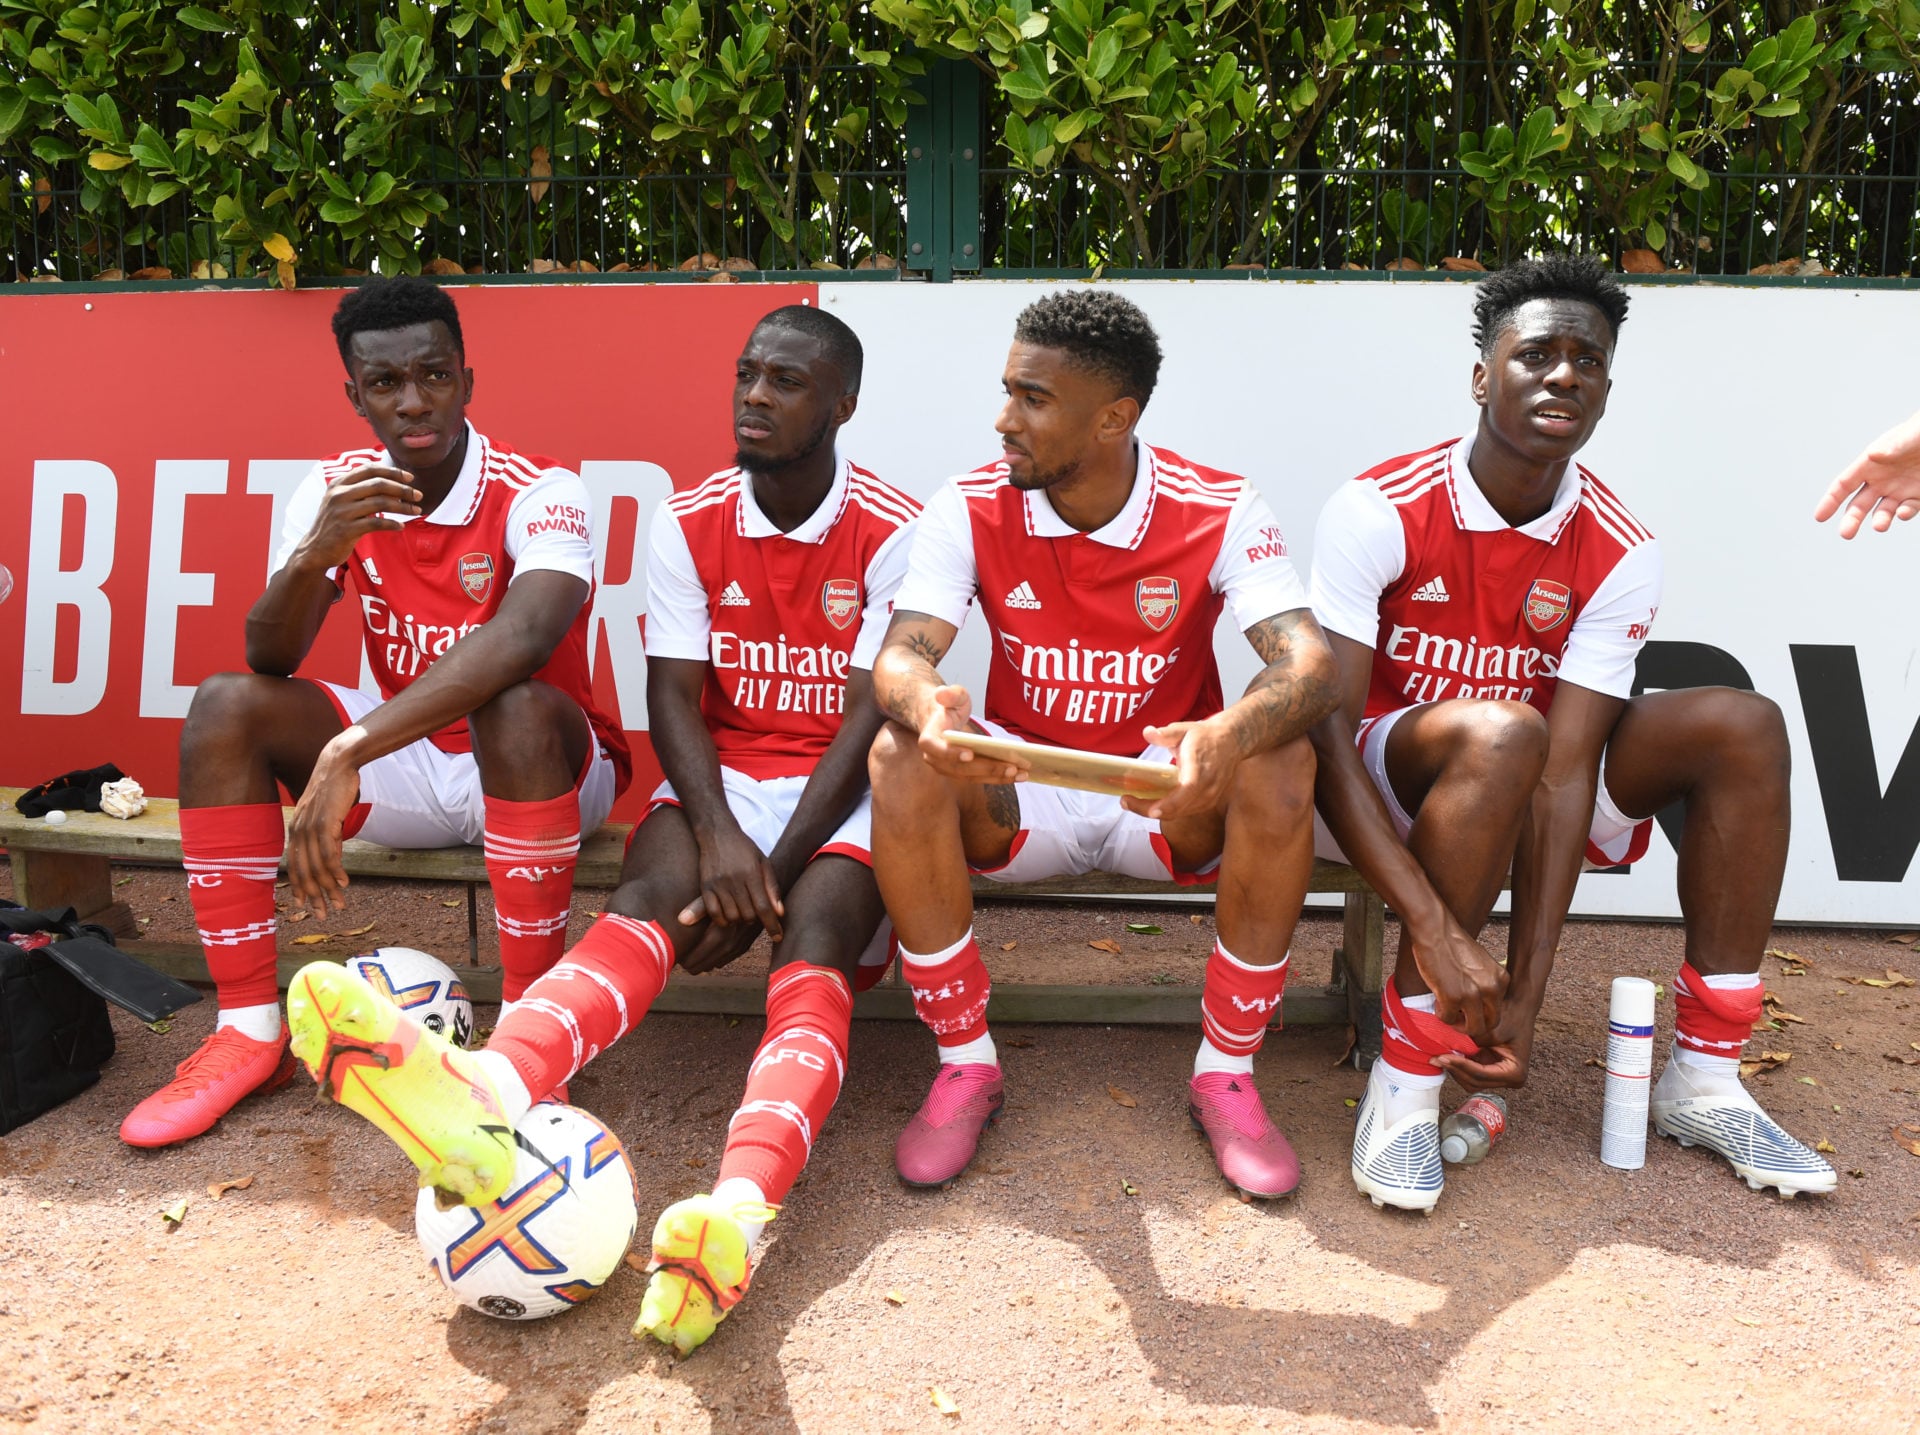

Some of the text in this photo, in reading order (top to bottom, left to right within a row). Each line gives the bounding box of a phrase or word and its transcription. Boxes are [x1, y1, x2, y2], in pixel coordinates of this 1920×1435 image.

[545, 504, 586, 523] VISIT
[462, 559, 489, 571] Arsenal
[20, 459, 675, 731] BER
[828, 586, 857, 596] Arsenal
[1141, 585, 1173, 595] Arsenal
[1411, 591, 1450, 602] adidas
[1531, 586, 1568, 603] Arsenal
[1004, 597, 1042, 610] adidas
[710, 631, 850, 680] Emirate
[1385, 623, 1561, 681] Emirates
[733, 676, 772, 710] FLY
[1023, 680, 1061, 717] FLY
[1402, 671, 1452, 703] FLY
[754, 1047, 826, 1077] AFC
